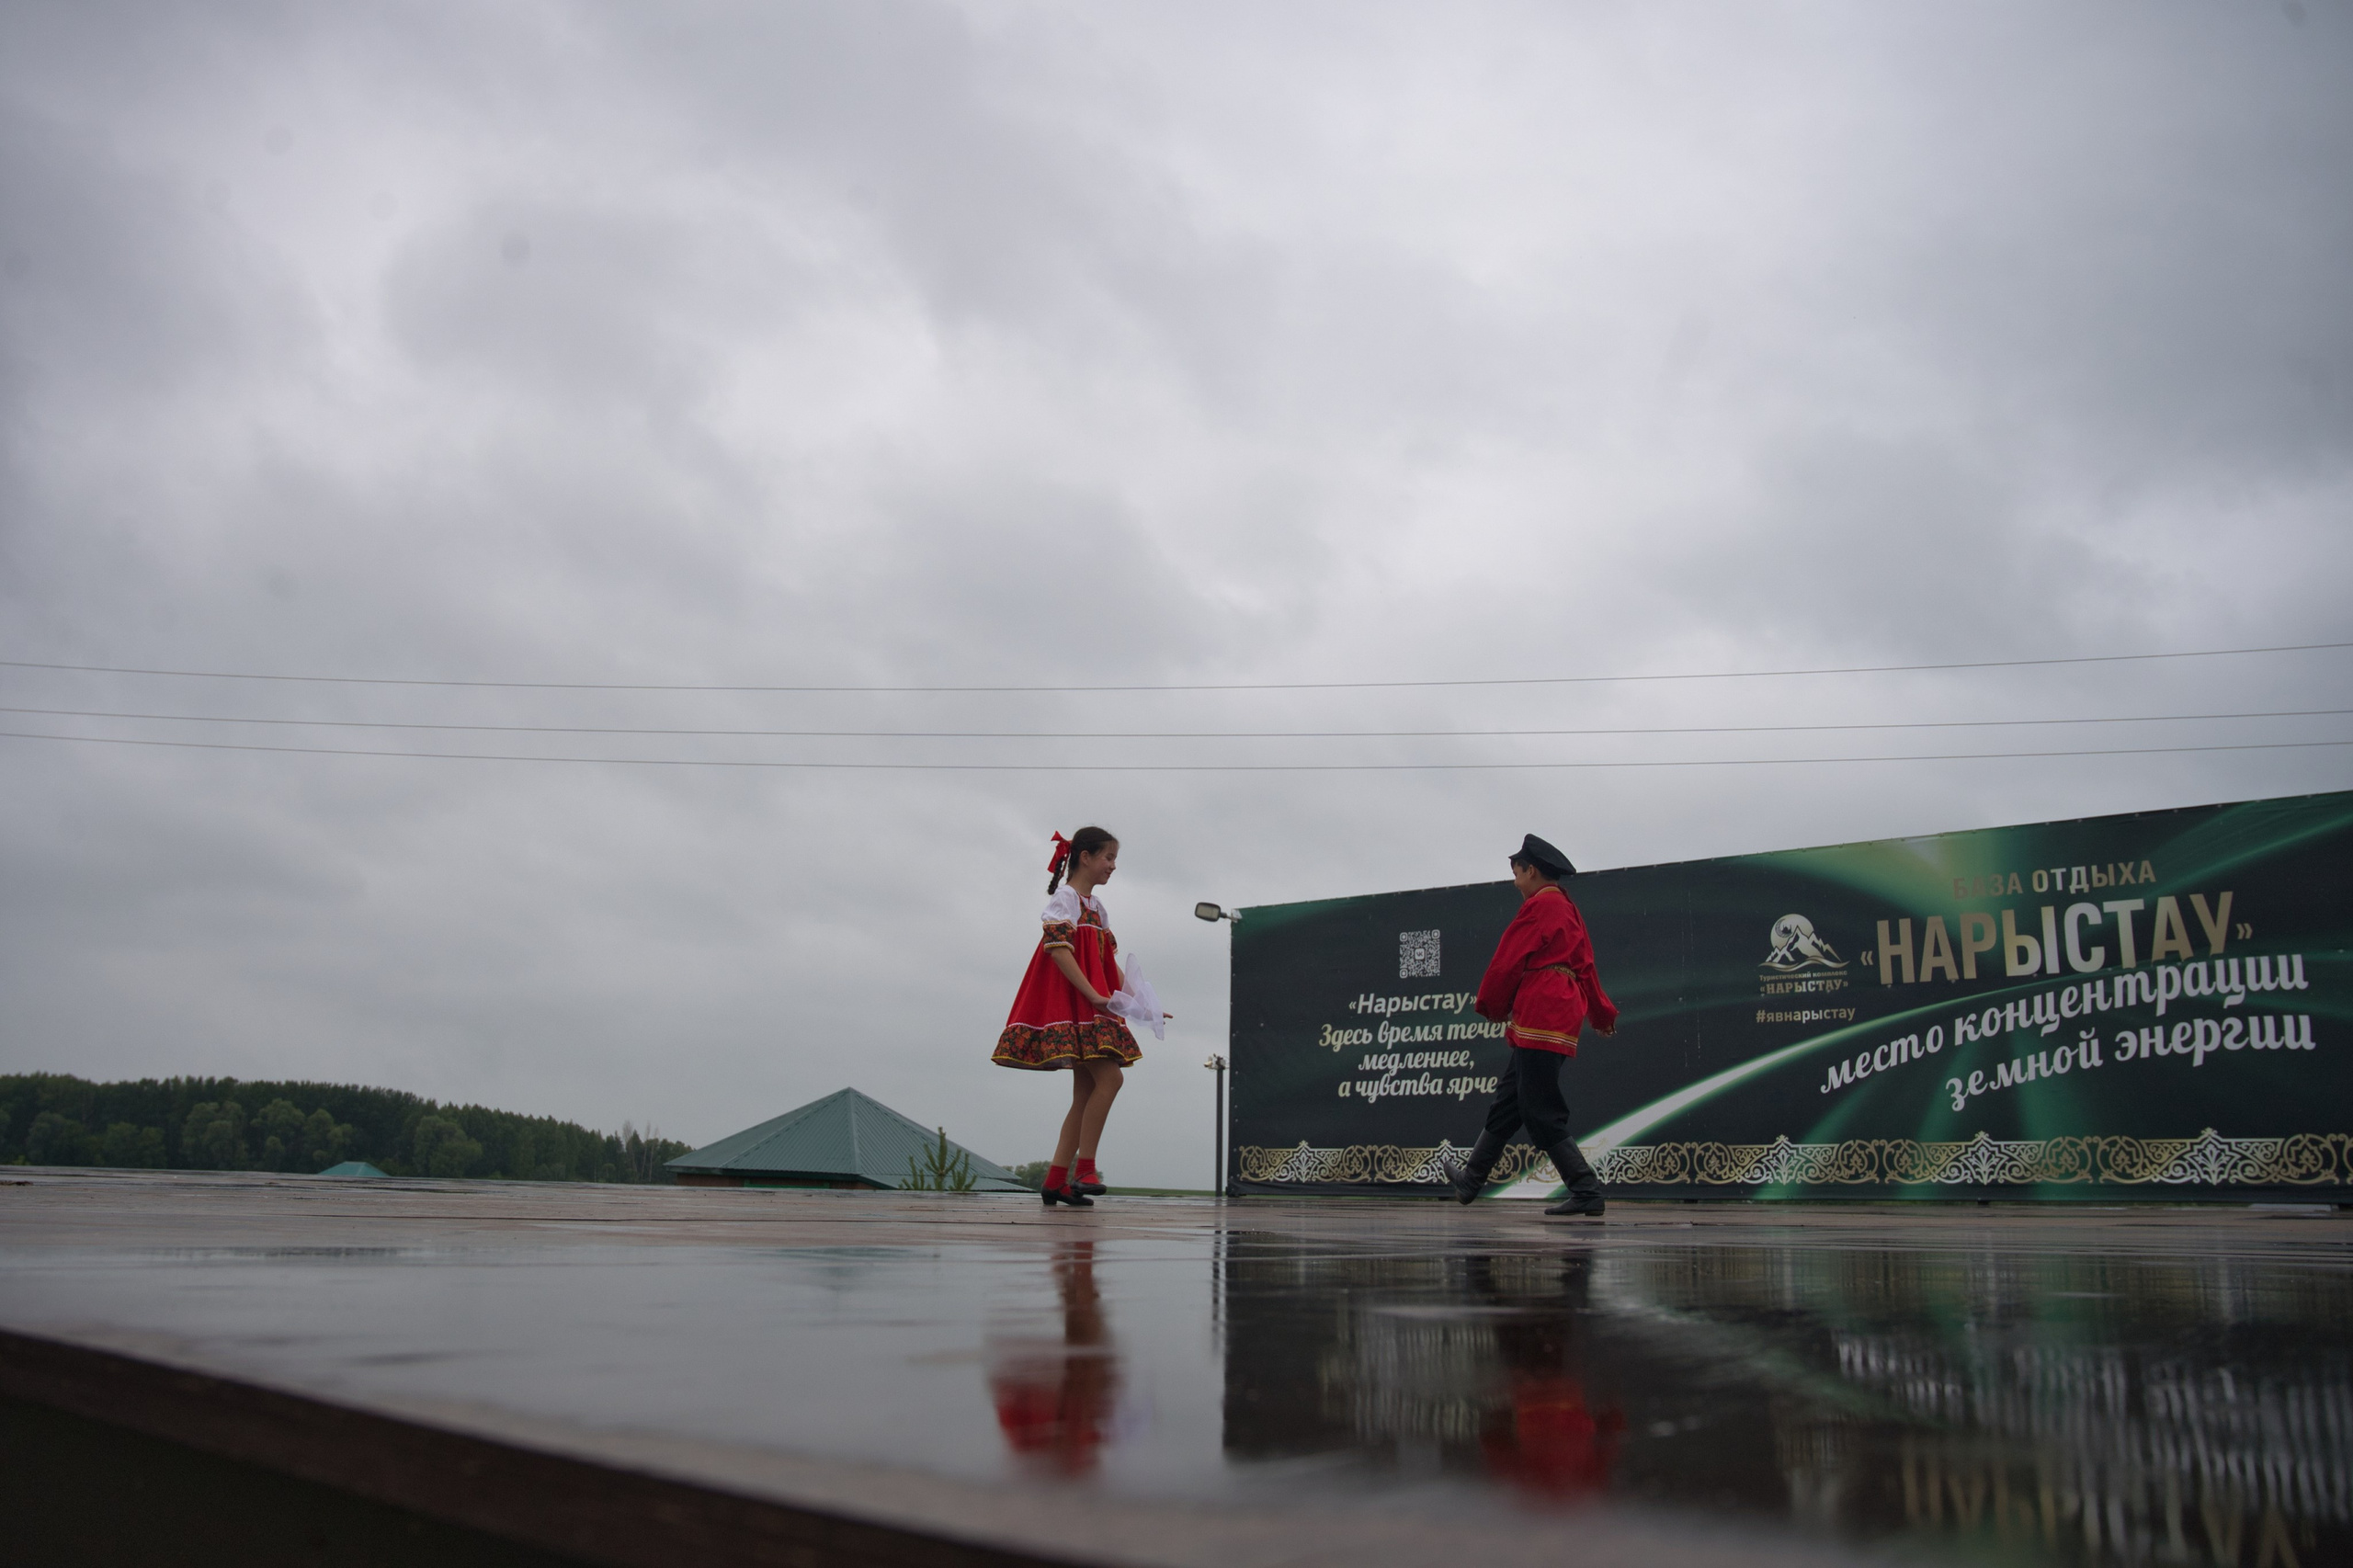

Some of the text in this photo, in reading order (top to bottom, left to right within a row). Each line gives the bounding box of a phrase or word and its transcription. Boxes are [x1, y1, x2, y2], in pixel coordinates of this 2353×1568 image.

[1952, 859, 2157, 901] БАЗА ОТДЫХА
[1860, 891, 2253, 985] «НАРЫСТАУ»
[1759, 971, 1812, 982] Туристический
[1760, 979, 1848, 994] «НАРЫСТАУ»
[1348, 992, 1477, 1017] «Нарыстау»
[1756, 1007, 1856, 1024] #явнарыстау
[1318, 1023, 1373, 1052] Здесь
[1378, 1020, 1443, 1050] время
[1820, 954, 2309, 1094] место концентрации
[1358, 1050, 1475, 1076] медленнее,
[1946, 1015, 2316, 1112] земной энергии
[1338, 1072, 1499, 1104] а чувства ярче
